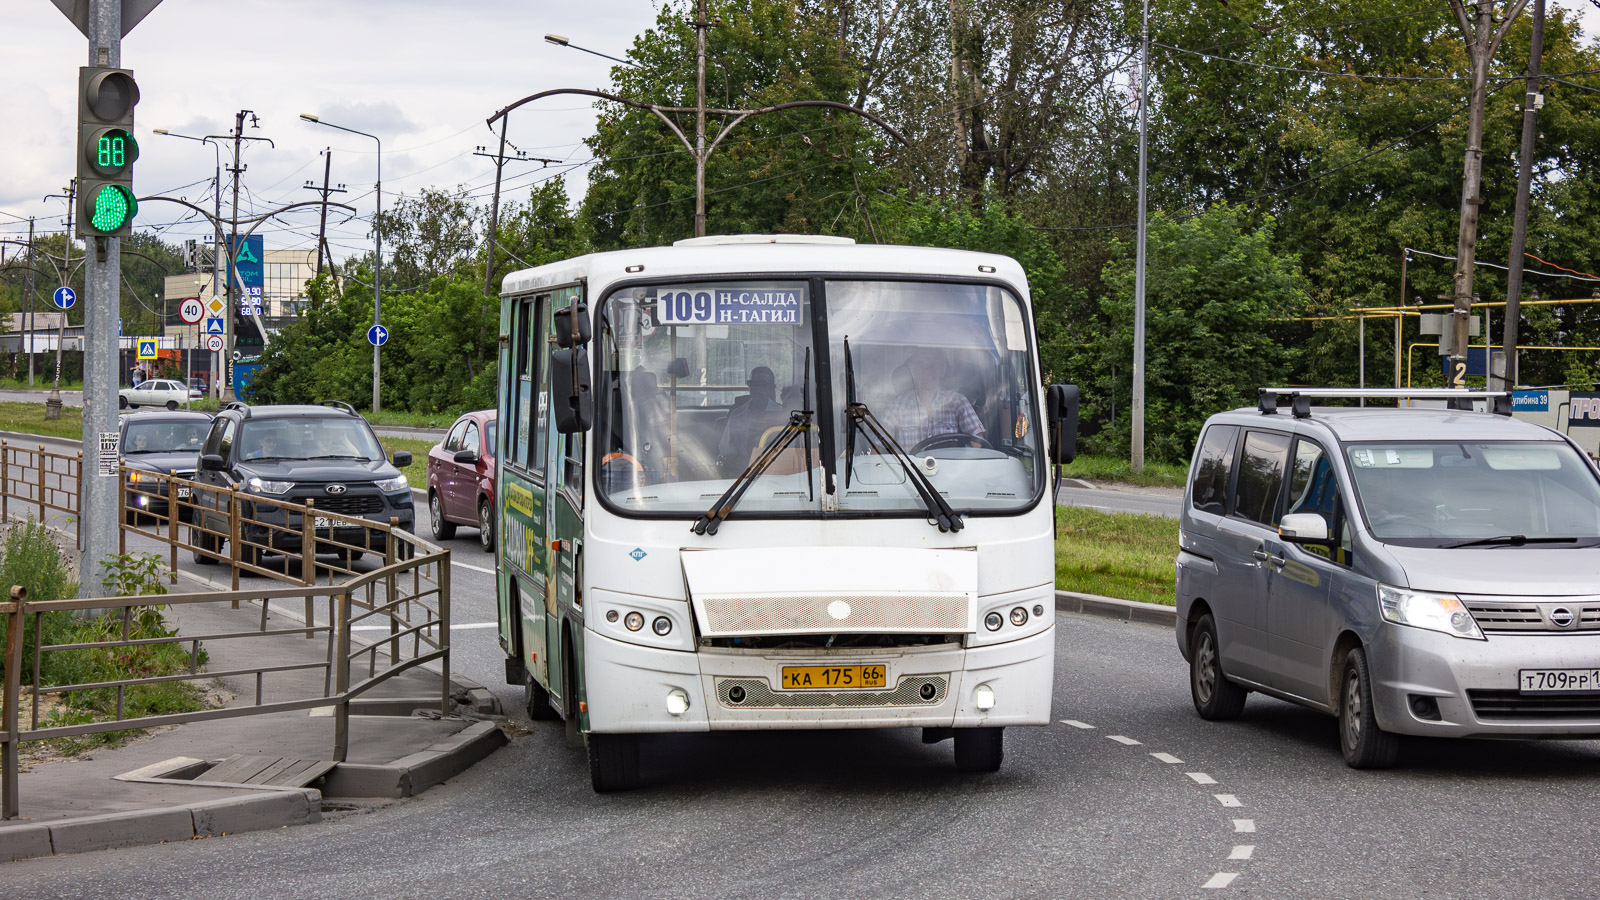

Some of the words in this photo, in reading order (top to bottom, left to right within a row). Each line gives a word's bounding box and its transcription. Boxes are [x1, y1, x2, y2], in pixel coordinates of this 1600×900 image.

[98, 137, 125, 167] 88
[661, 292, 712, 321] 109
[719, 292, 797, 308] Н-САЛДА
[184, 305, 198, 316] 40
[241, 307, 261, 316] 68.0
[719, 310, 796, 323] Н-ТАГИЛ
[210, 340, 220, 348] 20
[1511, 395, 1539, 407] улибина
[1539, 394, 1548, 405] 39
[1569, 397, 1600, 420] ПРО
[101, 442, 117, 451] ШУ
[791, 672, 813, 686] КА
[821, 668, 853, 685] 175
[862, 667, 880, 680] 66
[1526, 672, 1589, 689] Т709РР
